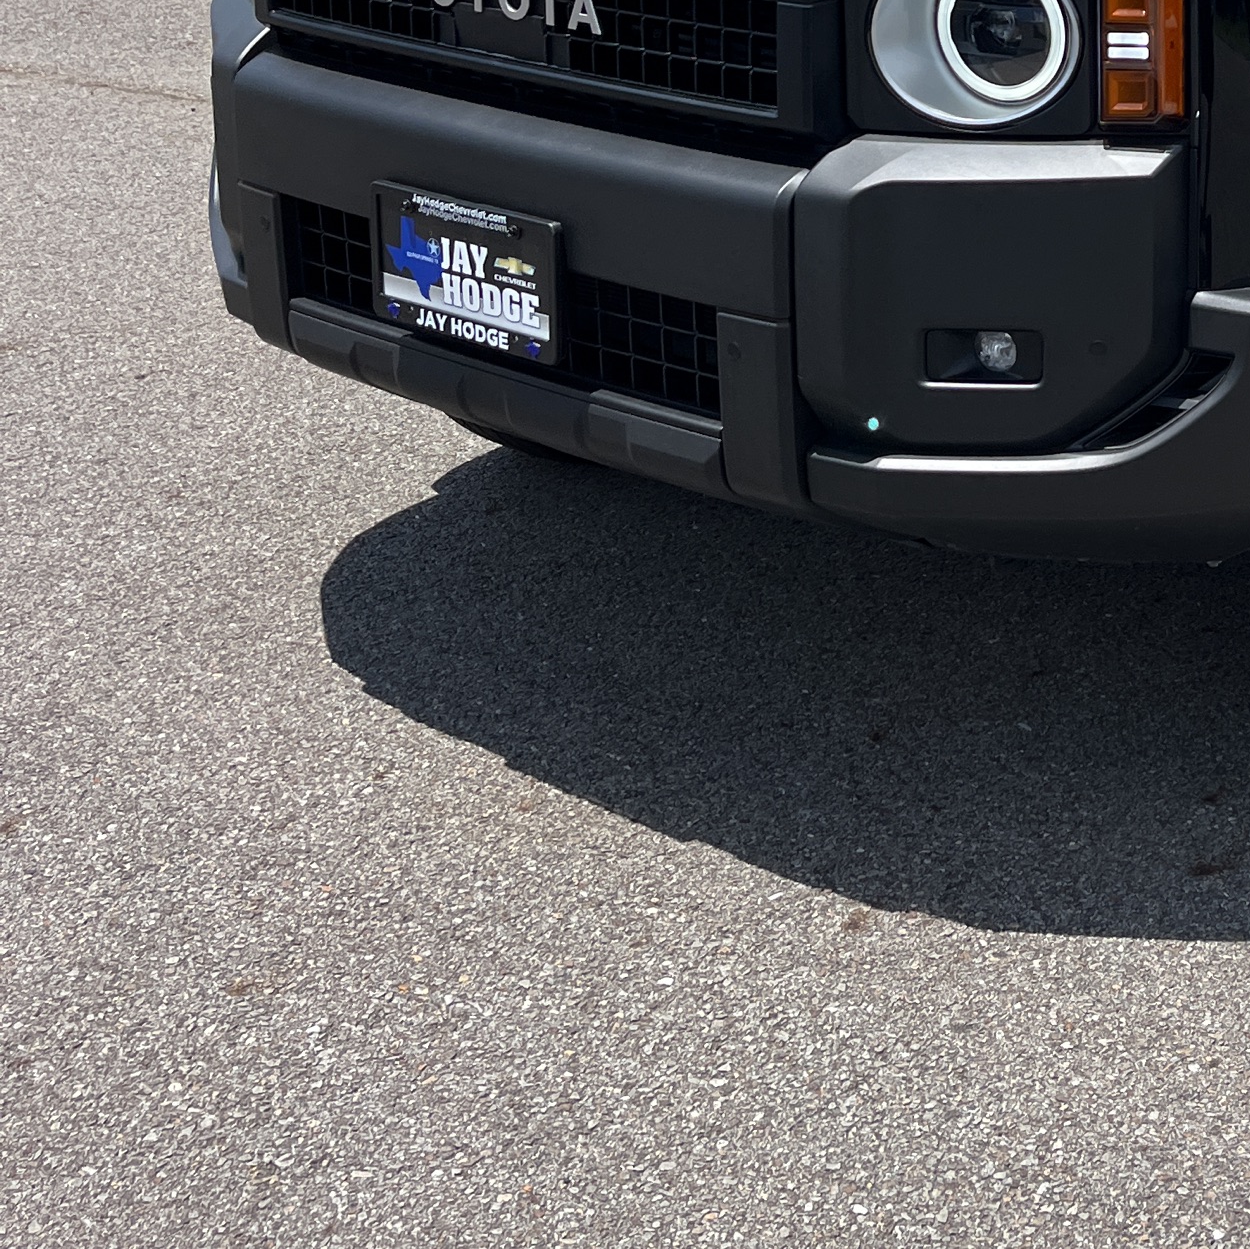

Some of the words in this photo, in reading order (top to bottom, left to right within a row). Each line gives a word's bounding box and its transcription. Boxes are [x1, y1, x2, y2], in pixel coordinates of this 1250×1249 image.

[412, 193, 507, 224] JayHodgeChevrolet.com
[440, 236, 488, 279] JAY
[441, 272, 540, 329] HODGE
[494, 273, 536, 290] CHEVROLET
[416, 308, 447, 332] JAY
[450, 317, 509, 350] HODGE
